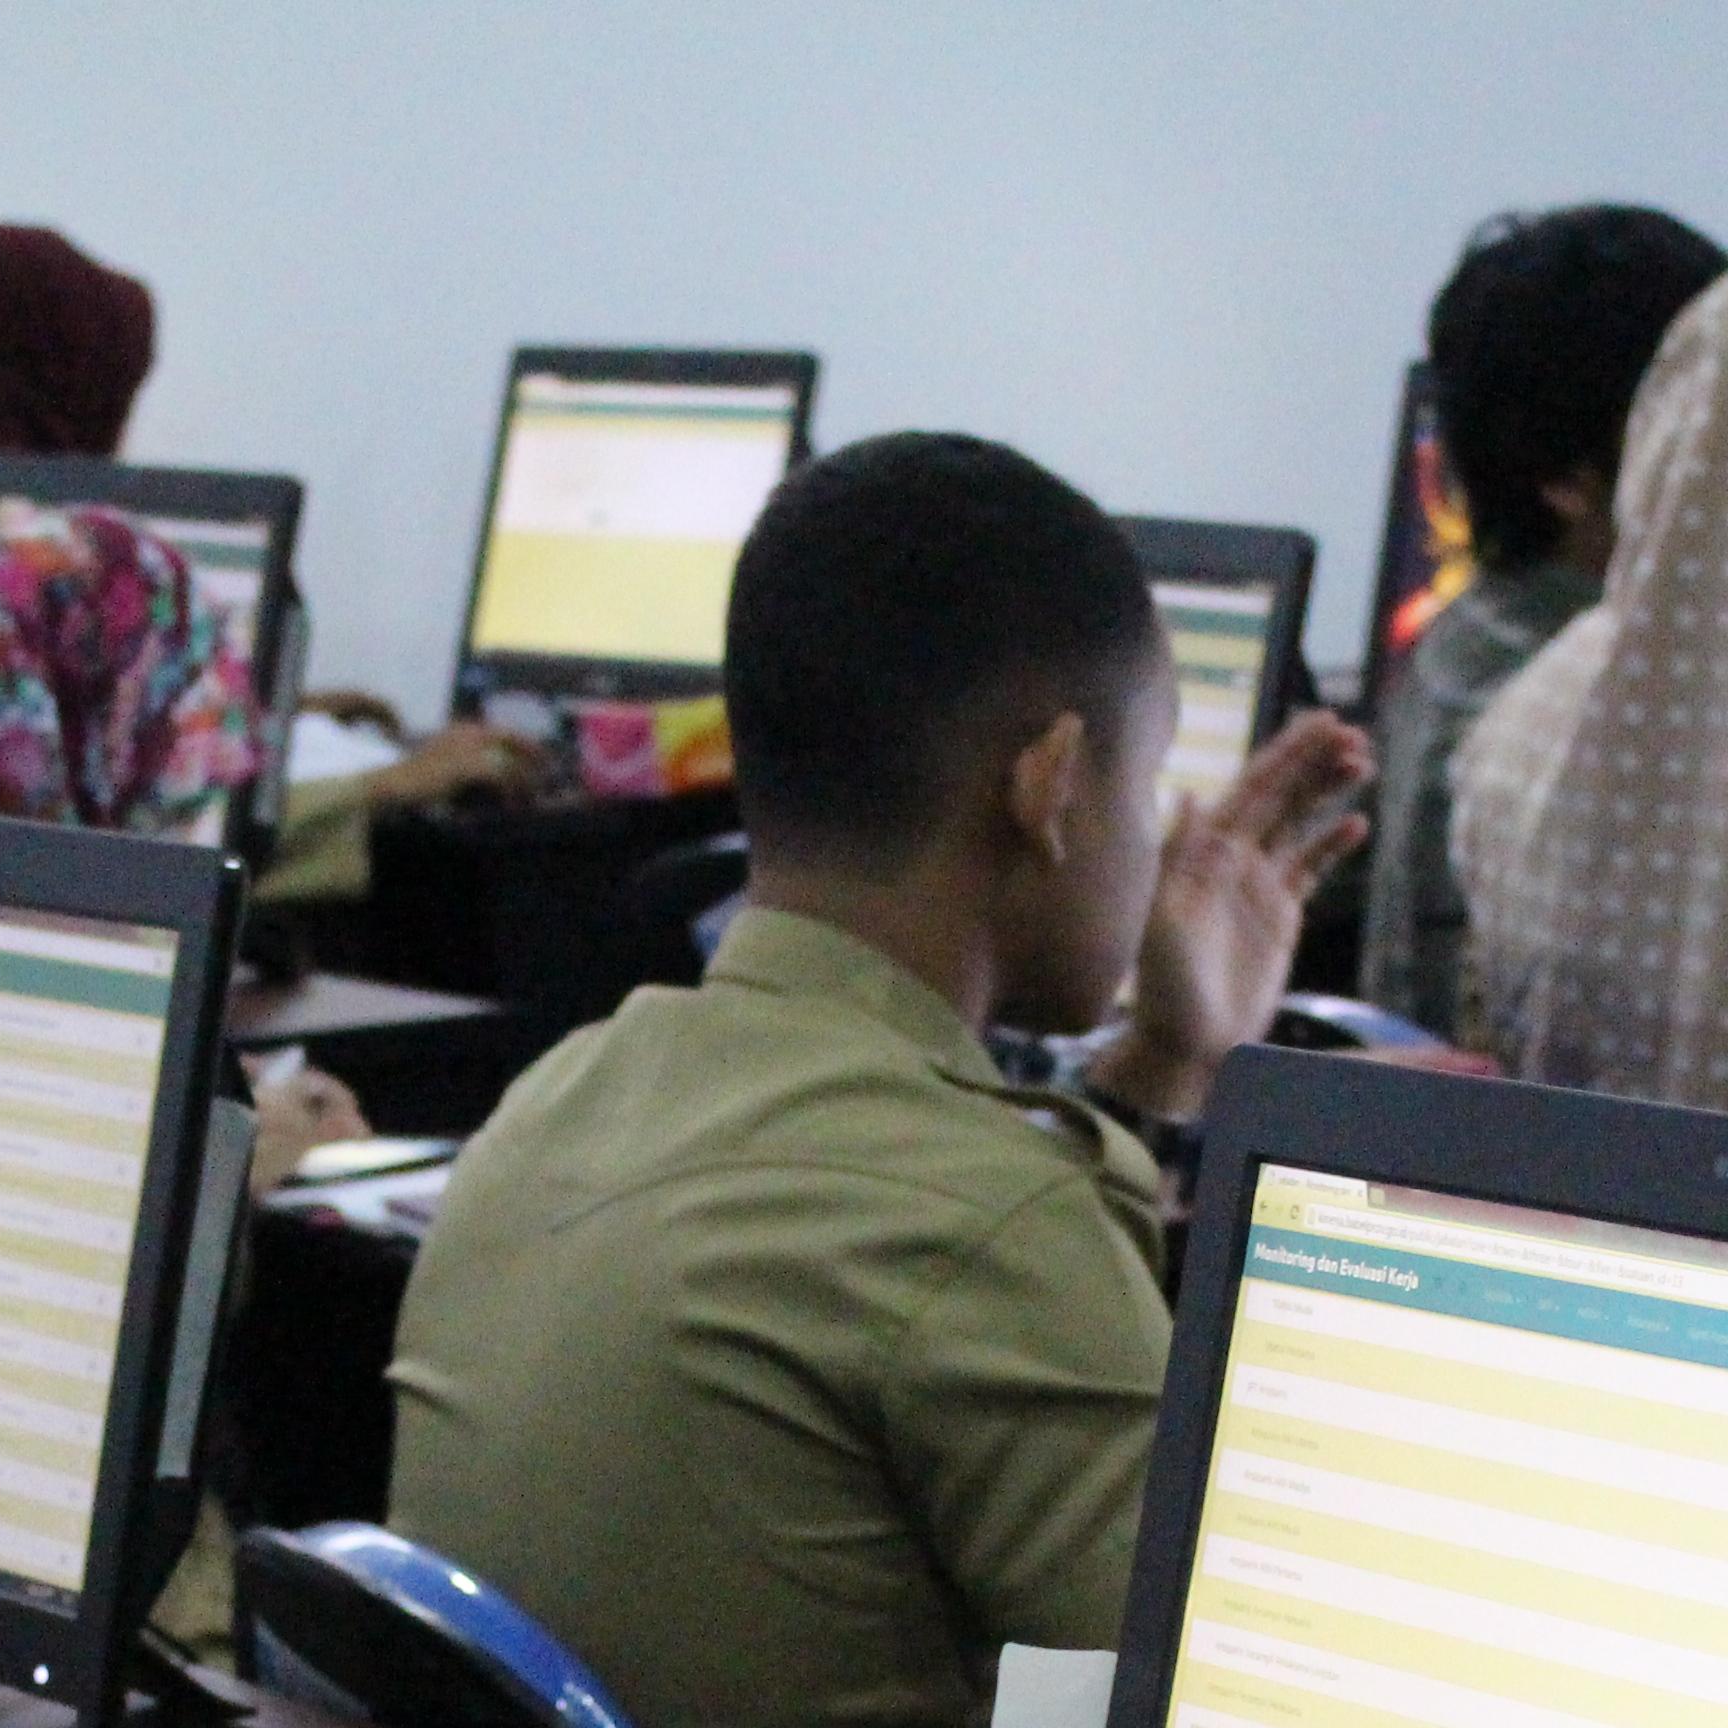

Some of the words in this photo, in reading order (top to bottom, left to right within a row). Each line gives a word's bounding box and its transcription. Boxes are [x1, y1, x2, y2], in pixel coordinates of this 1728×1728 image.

[1255, 1240, 1316, 1274] Monitoring
[1317, 1254, 1338, 1273] dan
[1340, 1257, 1387, 1285] Evaluasi
[1387, 1266, 1420, 1291] Kerja
